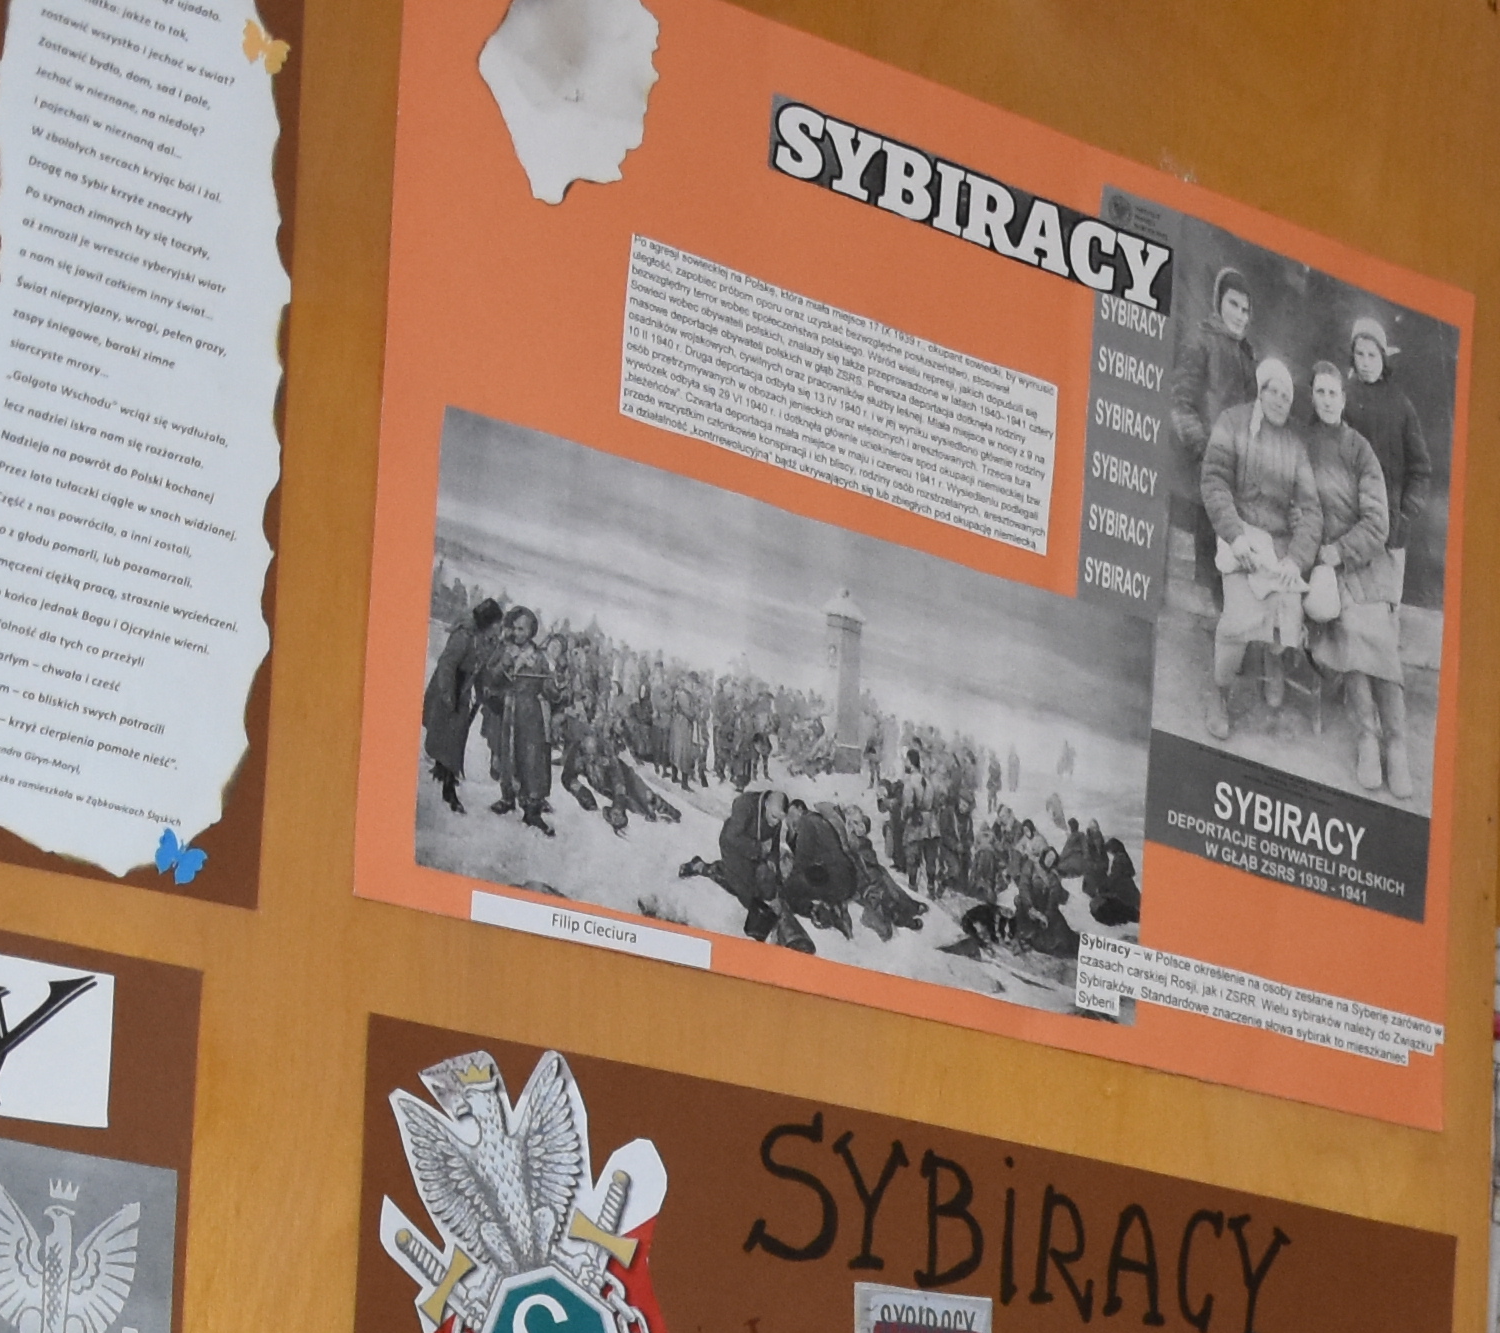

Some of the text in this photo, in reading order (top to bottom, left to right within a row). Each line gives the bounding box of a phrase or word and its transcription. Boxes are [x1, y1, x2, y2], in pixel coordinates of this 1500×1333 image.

[774, 103, 1171, 309] SYBIRACY
[1101, 294, 1166, 339] SYBIRACY
[1098, 345, 1164, 391] SYBIRACY
[1095, 398, 1160, 443] SYBIRACY
[1092, 451, 1157, 496] SYBIRACY
[1089, 503, 1154, 548] SYBIRACY
[1085, 556, 1150, 600] SYBIRACY
[8, 715, 37, 733] krzyż
[39, 725, 95, 748] cierpienia
[96, 741, 141, 760] pomoże
[142, 753, 178, 770] nieść”.
[1214, 782, 1365, 860] SYBIRACY
[1167, 810, 1404, 896] DEPORTACJE OBYWATELI POLSKICH
[1205, 841, 1218, 856] W
[1221, 845, 1258, 872] GŁĄB
[1260, 859, 1294, 883] ZSRS
[1299, 872, 1327, 892] 1939
[1339, 884, 1367, 904] 1941
[551, 913, 637, 944] Filip Cieciura
